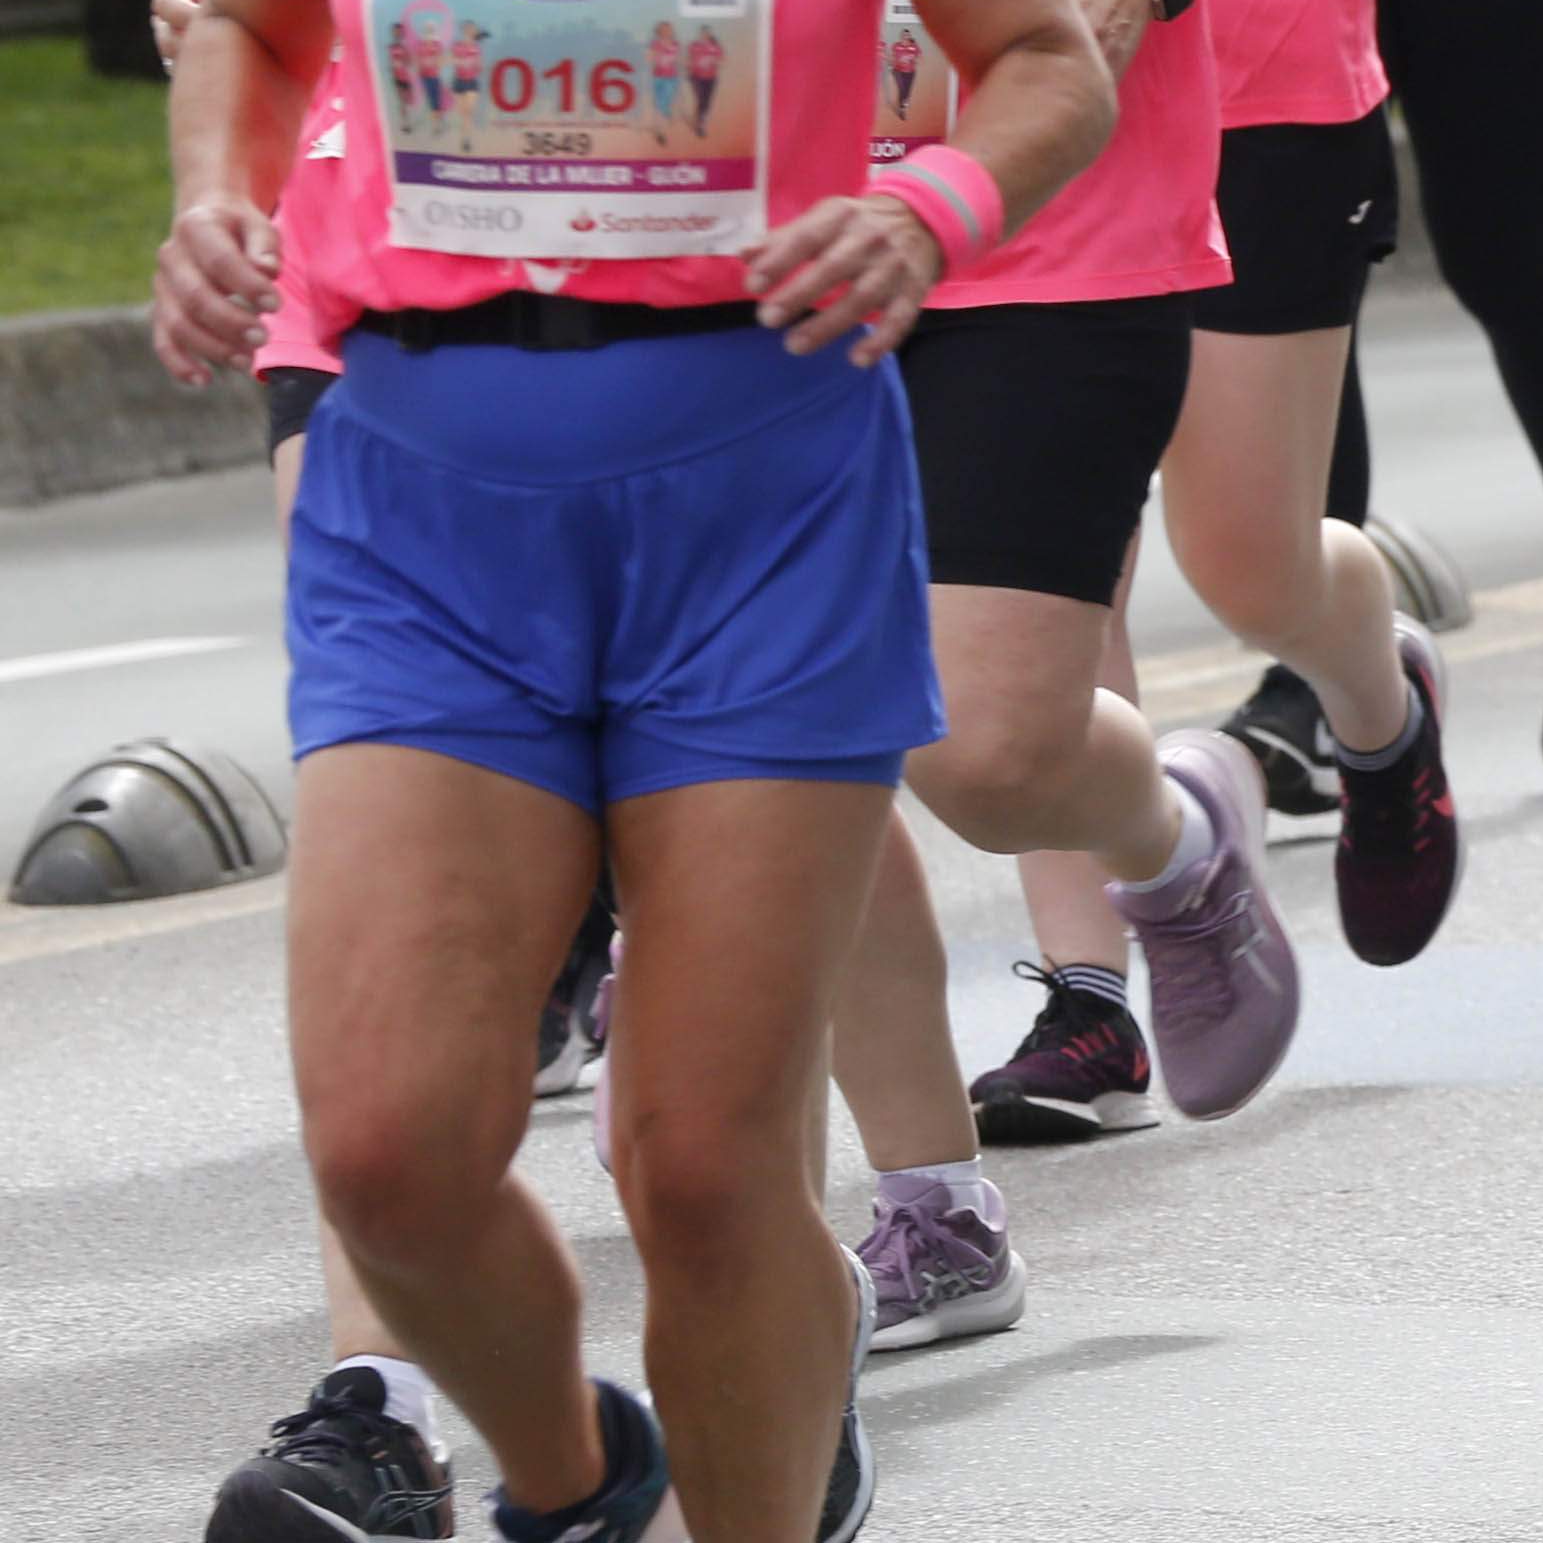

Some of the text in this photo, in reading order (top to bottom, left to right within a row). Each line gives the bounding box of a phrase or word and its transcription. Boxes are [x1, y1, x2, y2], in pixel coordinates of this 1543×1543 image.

[488, 57, 637, 115] 016
[521, 130, 593, 157] 3649
[600, 211, 720, 235] Santander
